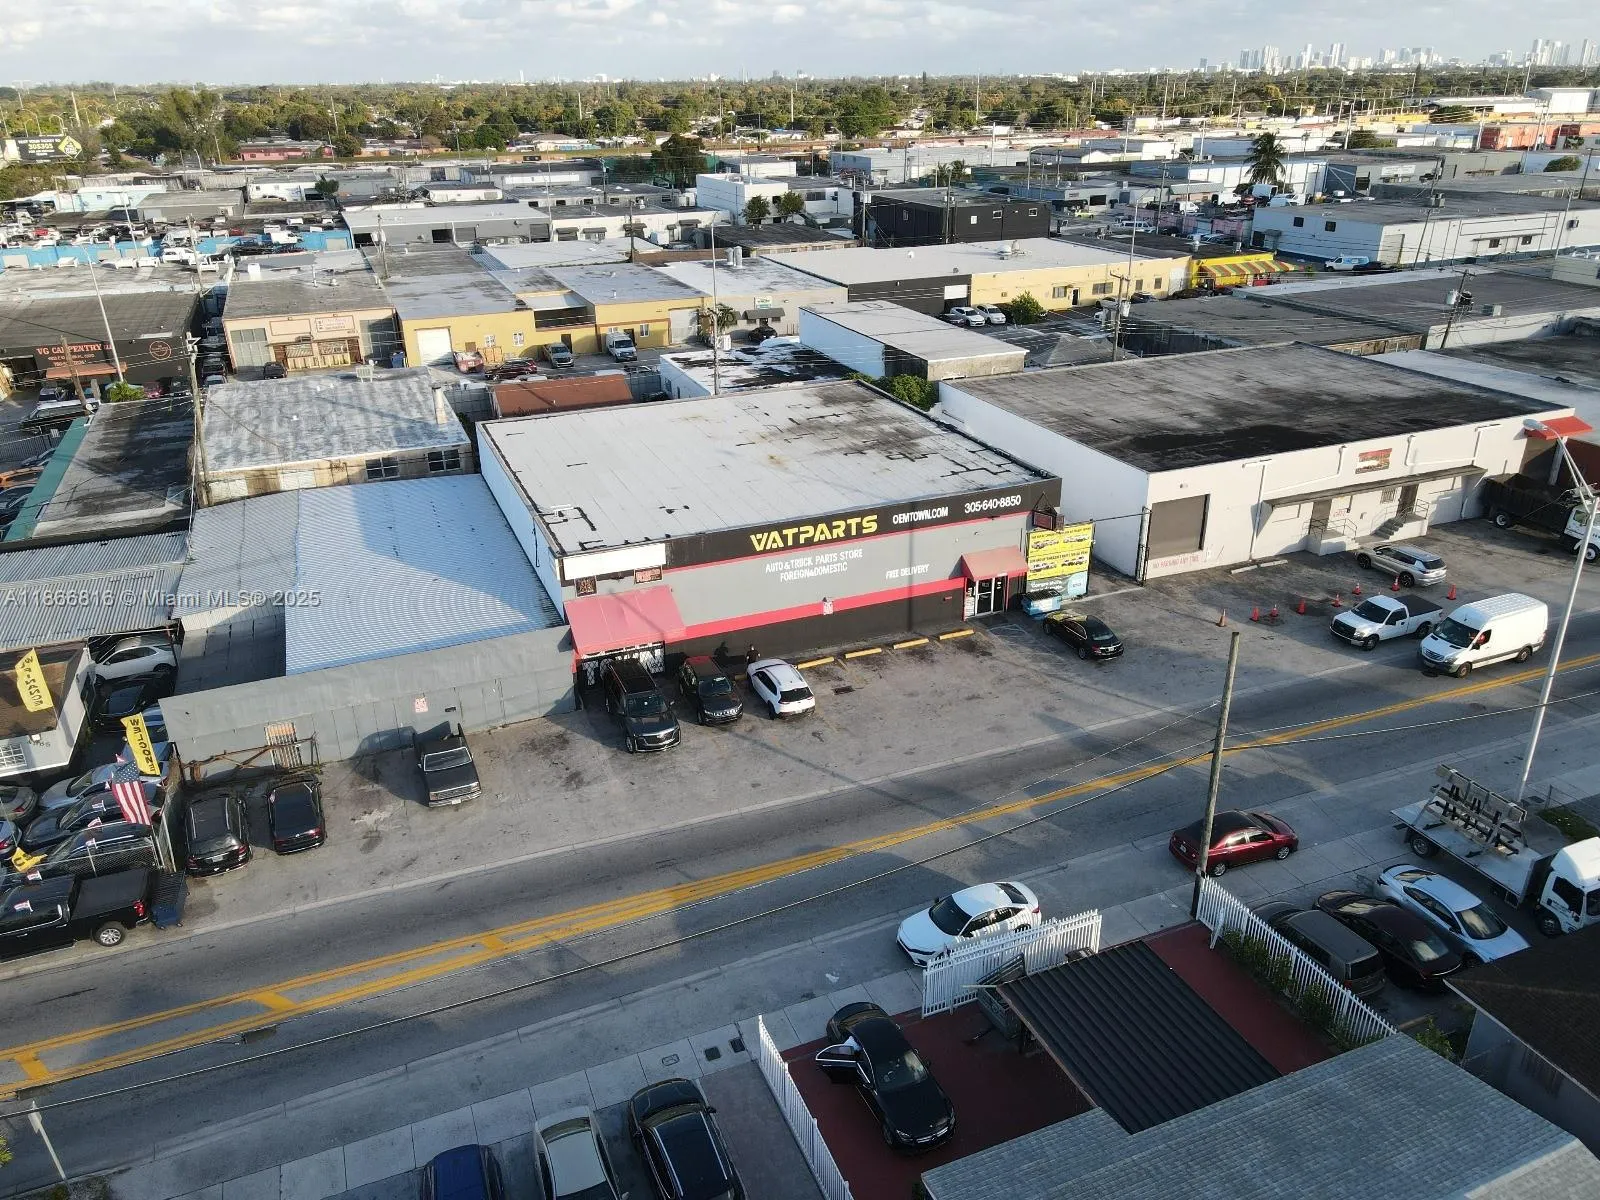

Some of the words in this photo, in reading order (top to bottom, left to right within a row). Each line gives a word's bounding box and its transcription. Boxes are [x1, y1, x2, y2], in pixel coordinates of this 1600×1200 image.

[36, 347, 50, 355] VG
[52, 344, 102, 354] CAPENTRY
[892, 507, 949, 525] OEMTOWN.COM
[750, 515, 878, 552] VATPARTS
[815, 553, 838, 564] PARTS
[840, 549, 863, 560] STORE
[886, 569, 899, 580] FREE
[900, 563, 930, 577] DELIVERY
